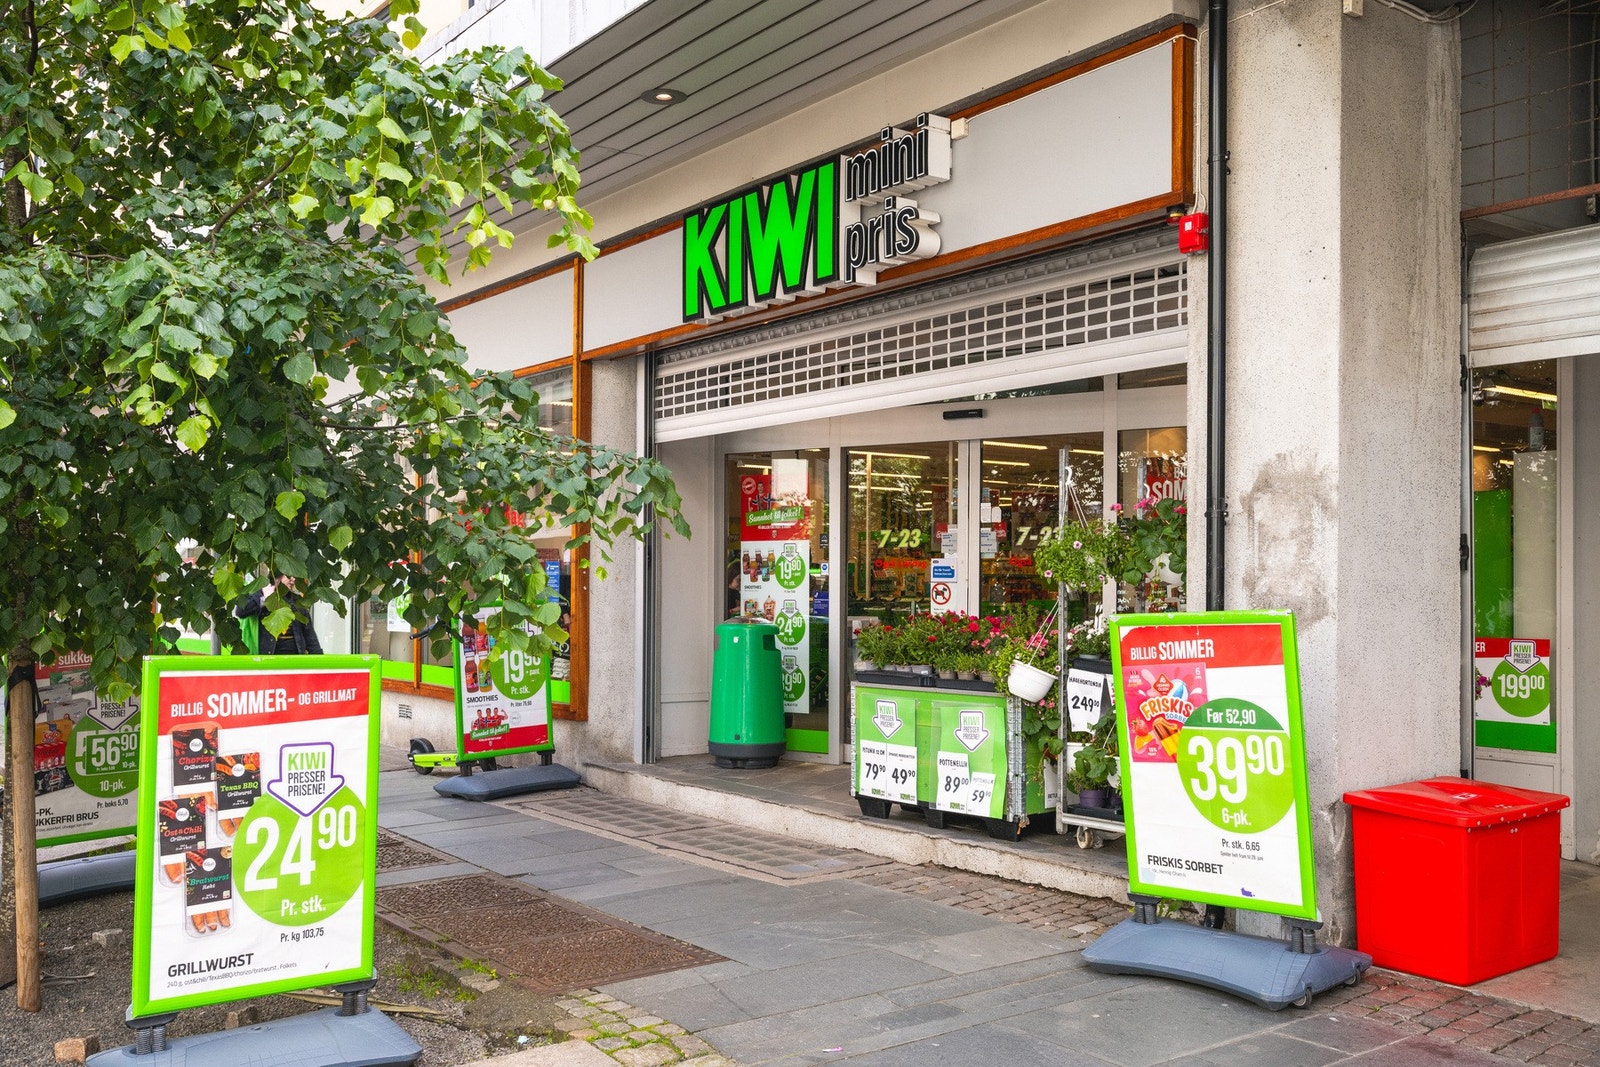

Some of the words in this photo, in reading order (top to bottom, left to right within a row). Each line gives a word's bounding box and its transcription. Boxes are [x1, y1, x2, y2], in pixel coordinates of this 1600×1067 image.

[845, 113, 928, 202] mini
[684, 156, 839, 322] KIWI
[844, 196, 919, 284] pris
[878, 529, 922, 548] 7-23
[1130, 646, 1157, 661] BILLIG
[1158, 639, 1215, 660] SOMMER
[1514, 644, 1531, 653] KIWI
[170, 702, 203, 718] BILLIG
[207, 688, 295, 718] SOMMER-
[298, 692, 311, 706] OG
[313, 688, 357, 704] GRILLMAT
[466, 694, 498, 704] SMOOTHIES
[100, 710, 126, 718] PRISENE!
[1140, 697, 1192, 719] FRISKIS
[1206, 708, 1223, 724] Før
[1225, 708, 1256, 725] 52,90
[178, 755, 215, 765] Chorizo
[287, 751, 326, 769] KIWI
[287, 769, 326, 784] PRESSER
[100, 779, 126, 792] 10-pk.
[243, 781, 259, 790] BBQ
[287, 783, 326, 798] PRISENE!
[35, 814, 75, 827] UKKERFRI
[76, 811, 99, 821] BRUS
[36, 807, 54, 816] -PK.
[1221, 808, 1252, 828] 6-pk.
[1221, 838, 1231, 848] Pr.
[1232, 840, 1244, 850] stk.
[1245, 841, 1260, 852] 6,65
[1147, 855, 1183, 869] FRISKIS
[1185, 860, 1223, 875] SORBET
[190, 874, 229, 886] Bratwurst
[280, 898, 297, 917] Pr.
[301, 895, 326, 914] stk.
[280, 932, 290, 943] Pr.
[291, 931, 300, 943] kg
[302, 927, 324, 940] 103,75
[168, 953, 254, 977] GRILLWURST
